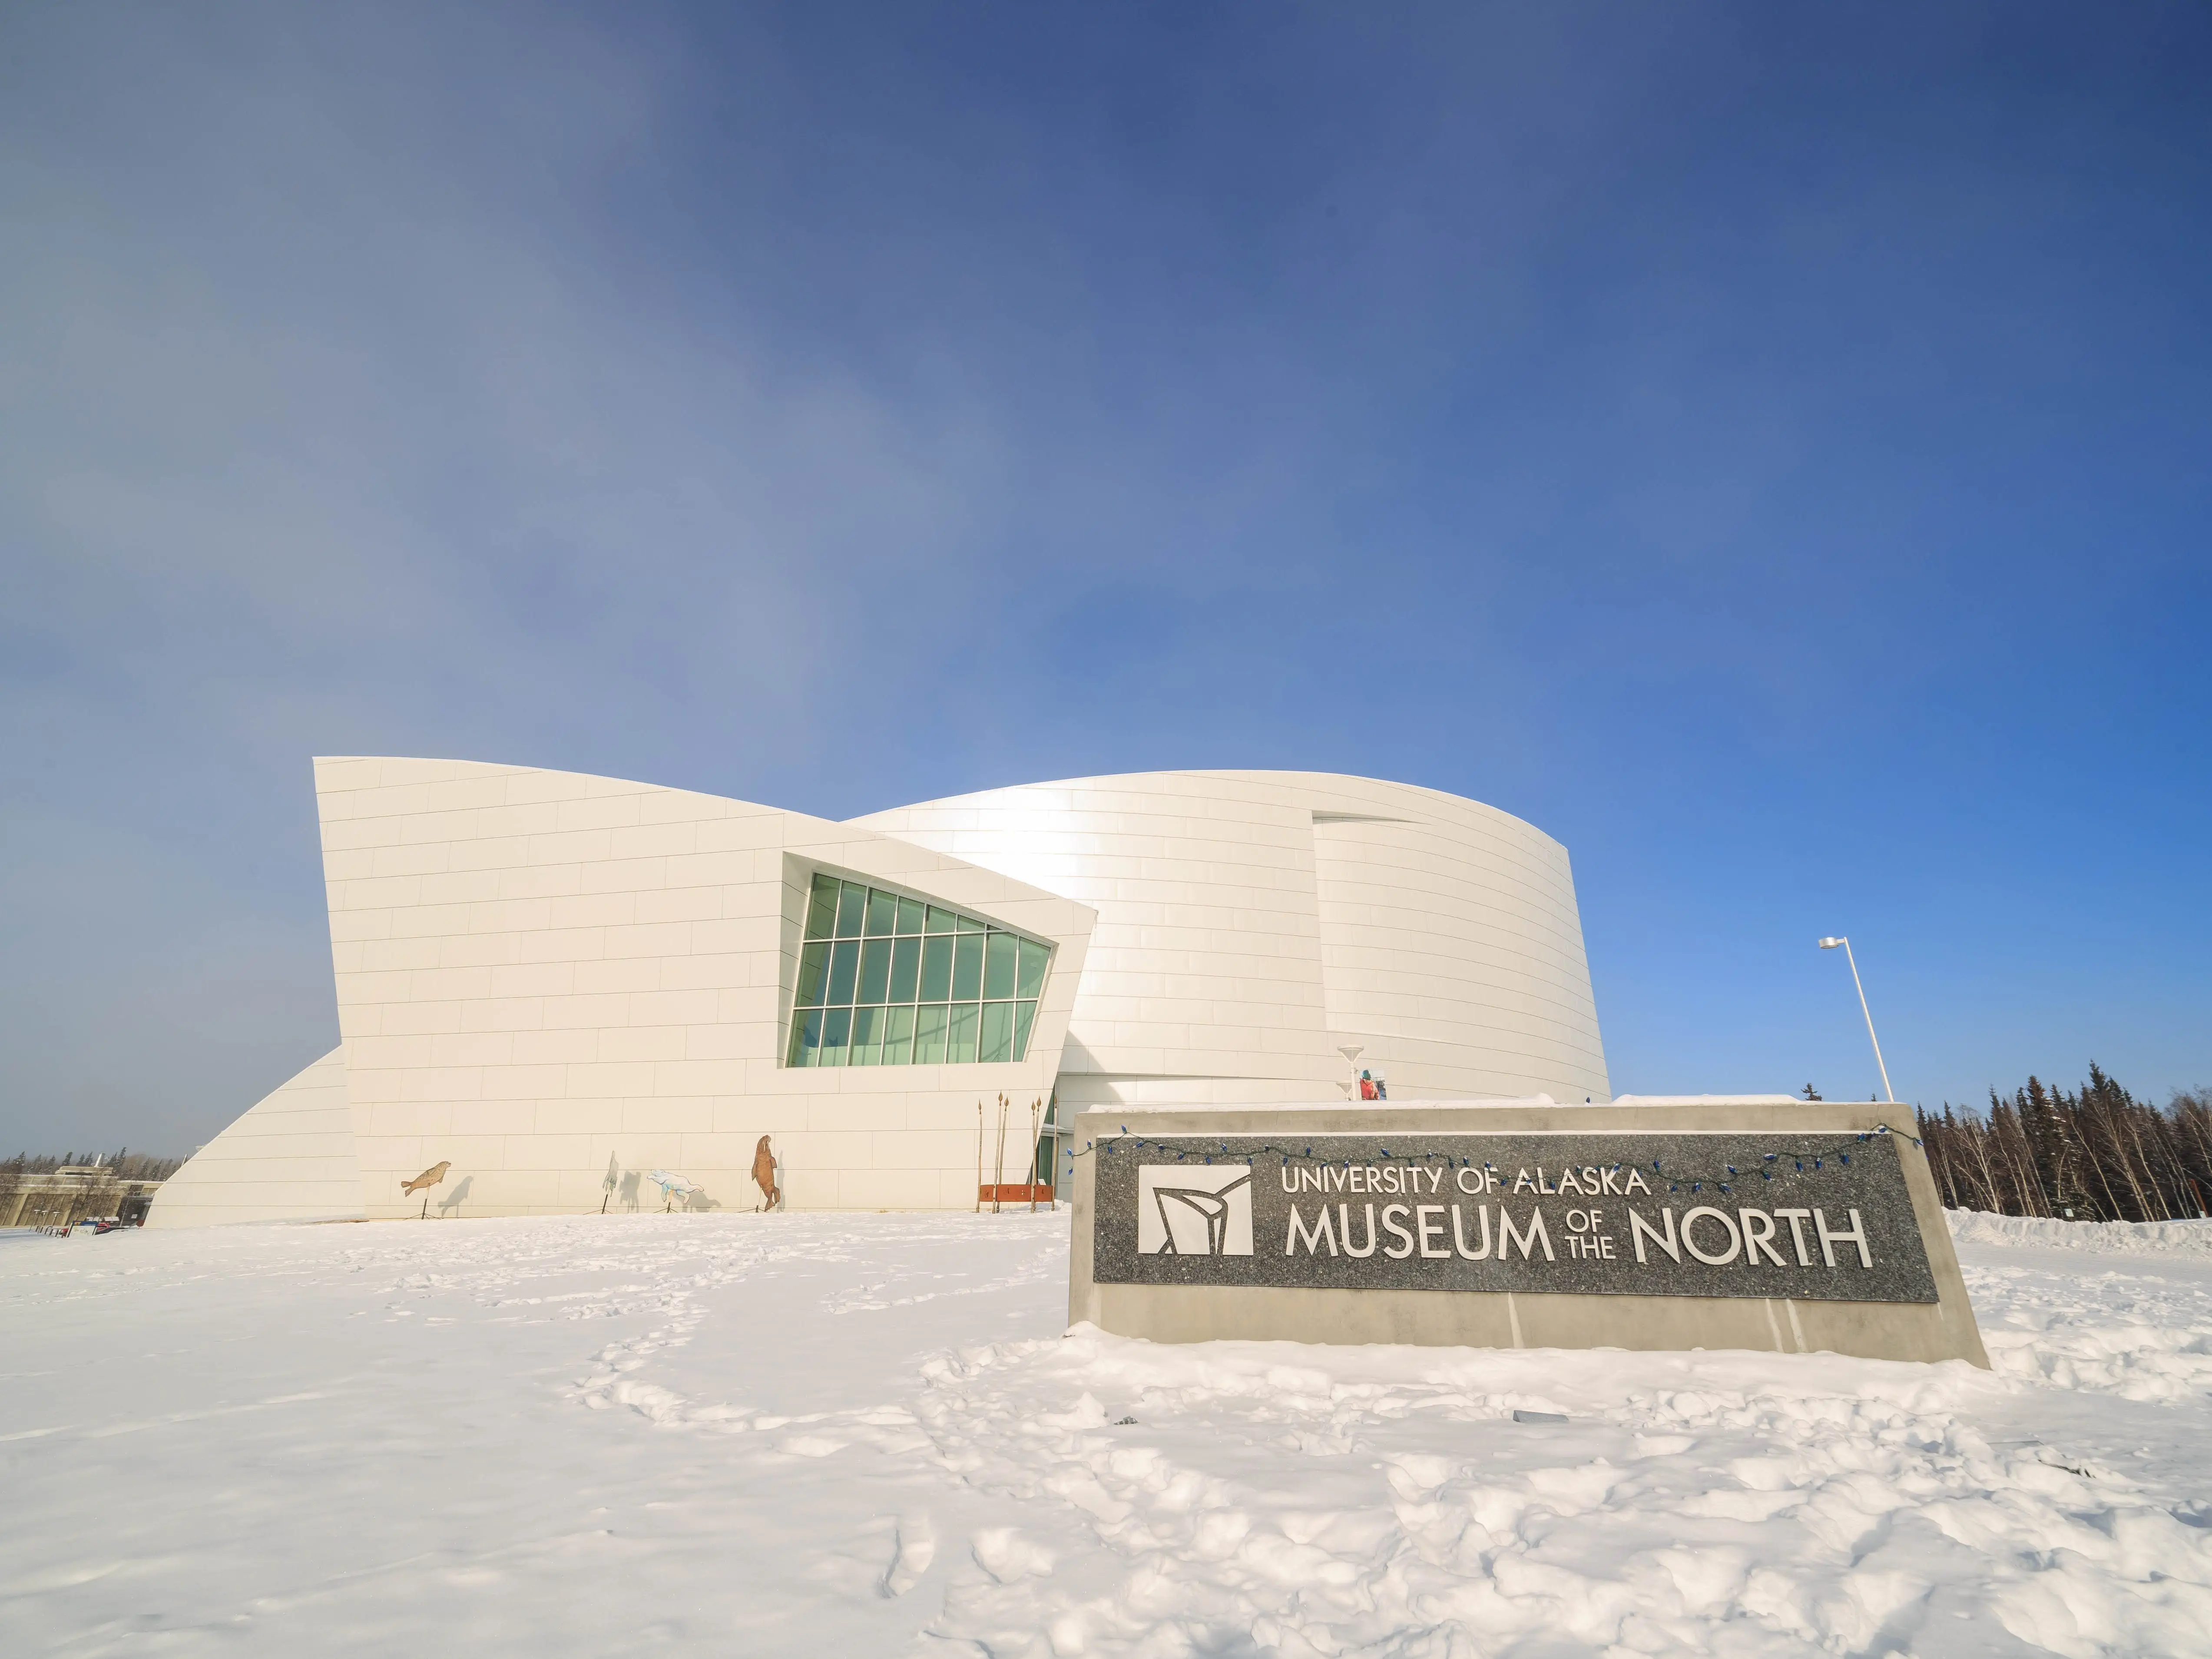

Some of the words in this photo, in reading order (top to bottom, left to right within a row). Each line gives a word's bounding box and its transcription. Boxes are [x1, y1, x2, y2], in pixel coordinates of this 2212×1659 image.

[1282, 1166, 1443, 1193] UNIVERSITY
[1457, 1167, 1498, 1194] OF
[1513, 1167, 1652, 1195] ALASKA
[1285, 1203, 1555, 1262] MUSEUM
[1566, 1209, 1603, 1232] OF
[1564, 1235, 1616, 1259] THE
[1628, 1206, 1873, 1268] NORTH
